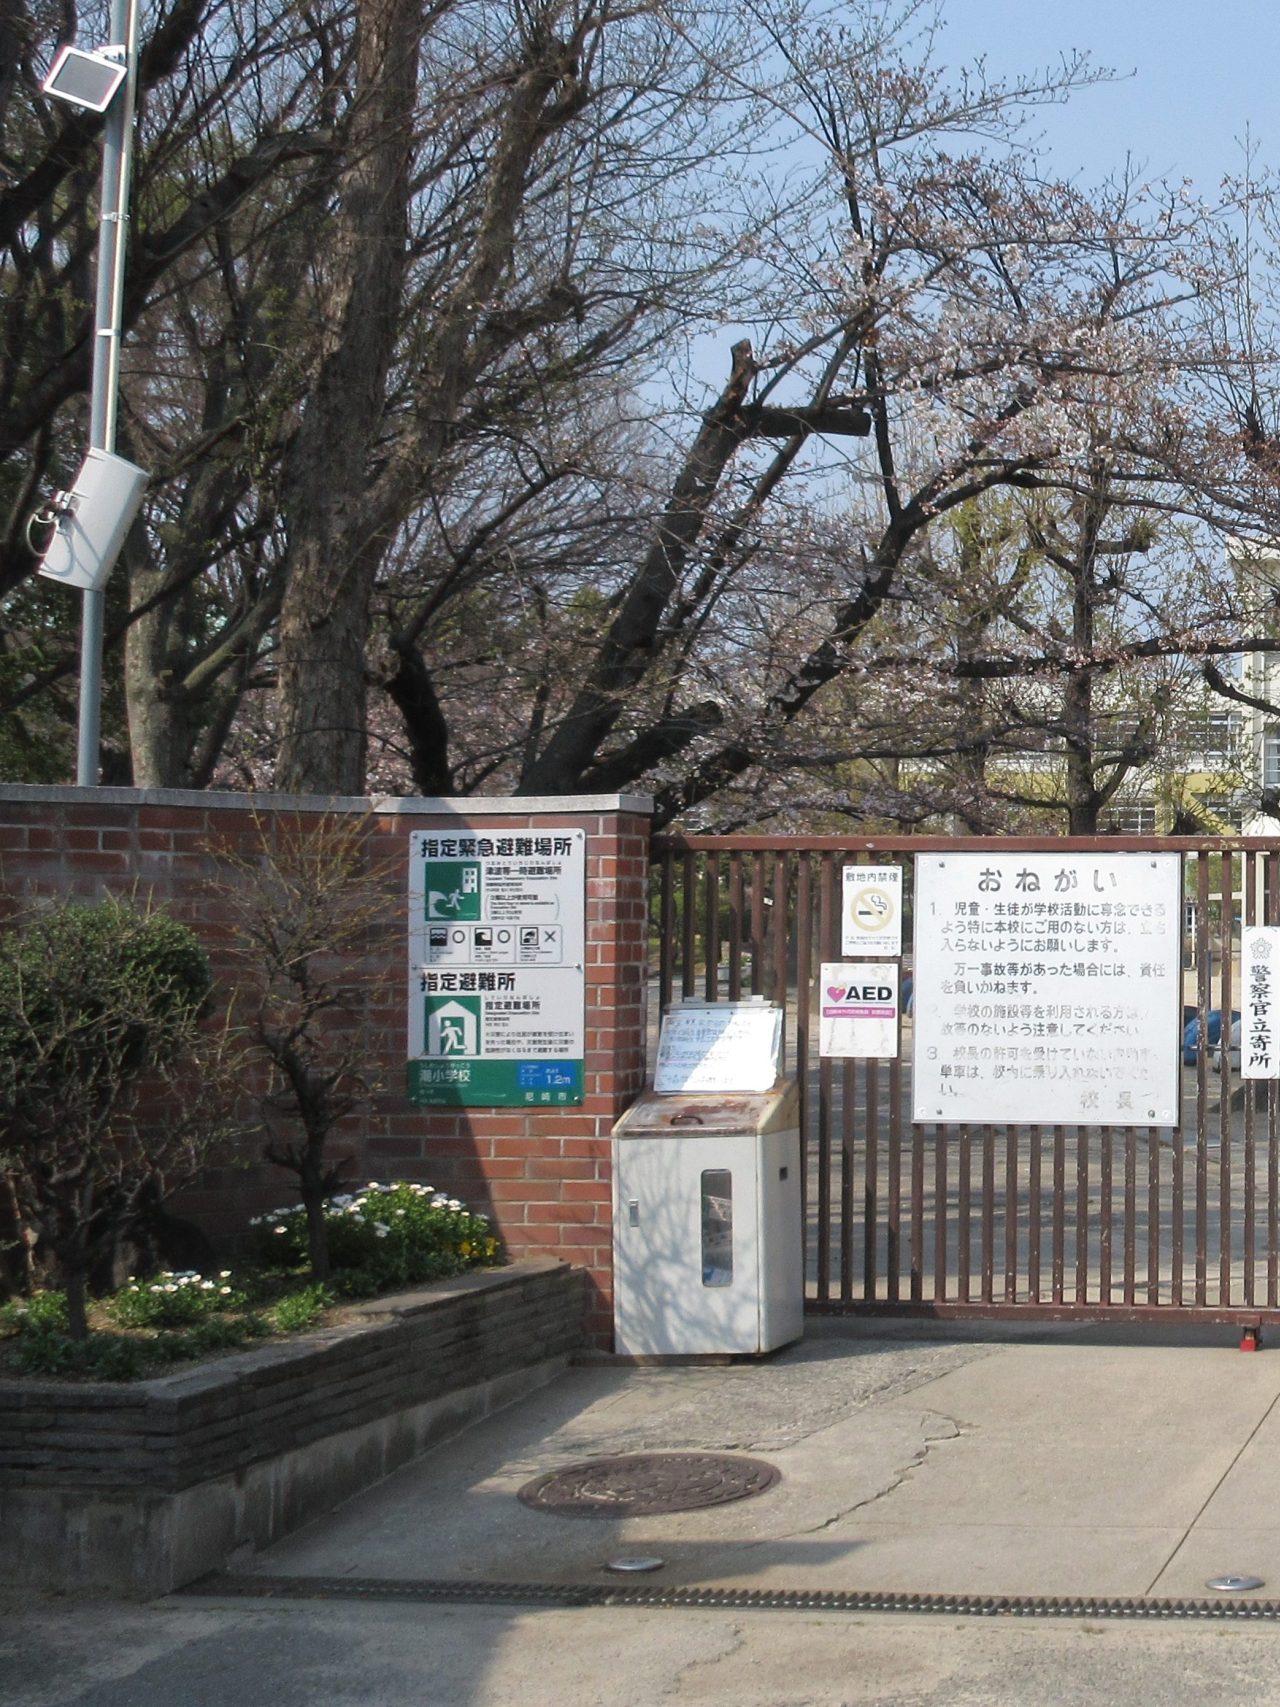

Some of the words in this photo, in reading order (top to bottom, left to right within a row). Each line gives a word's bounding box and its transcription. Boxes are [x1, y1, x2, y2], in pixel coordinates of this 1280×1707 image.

[421, 837, 572, 857] 指定緊急避難場所
[845, 872, 899, 882] 敷地内禁煙
[977, 867, 1118, 892] おねがい
[421, 972, 516, 992] 指定避難所
[846, 986, 893, 1001] AED
[1249, 965, 1272, 1069] 警察官立寄所
